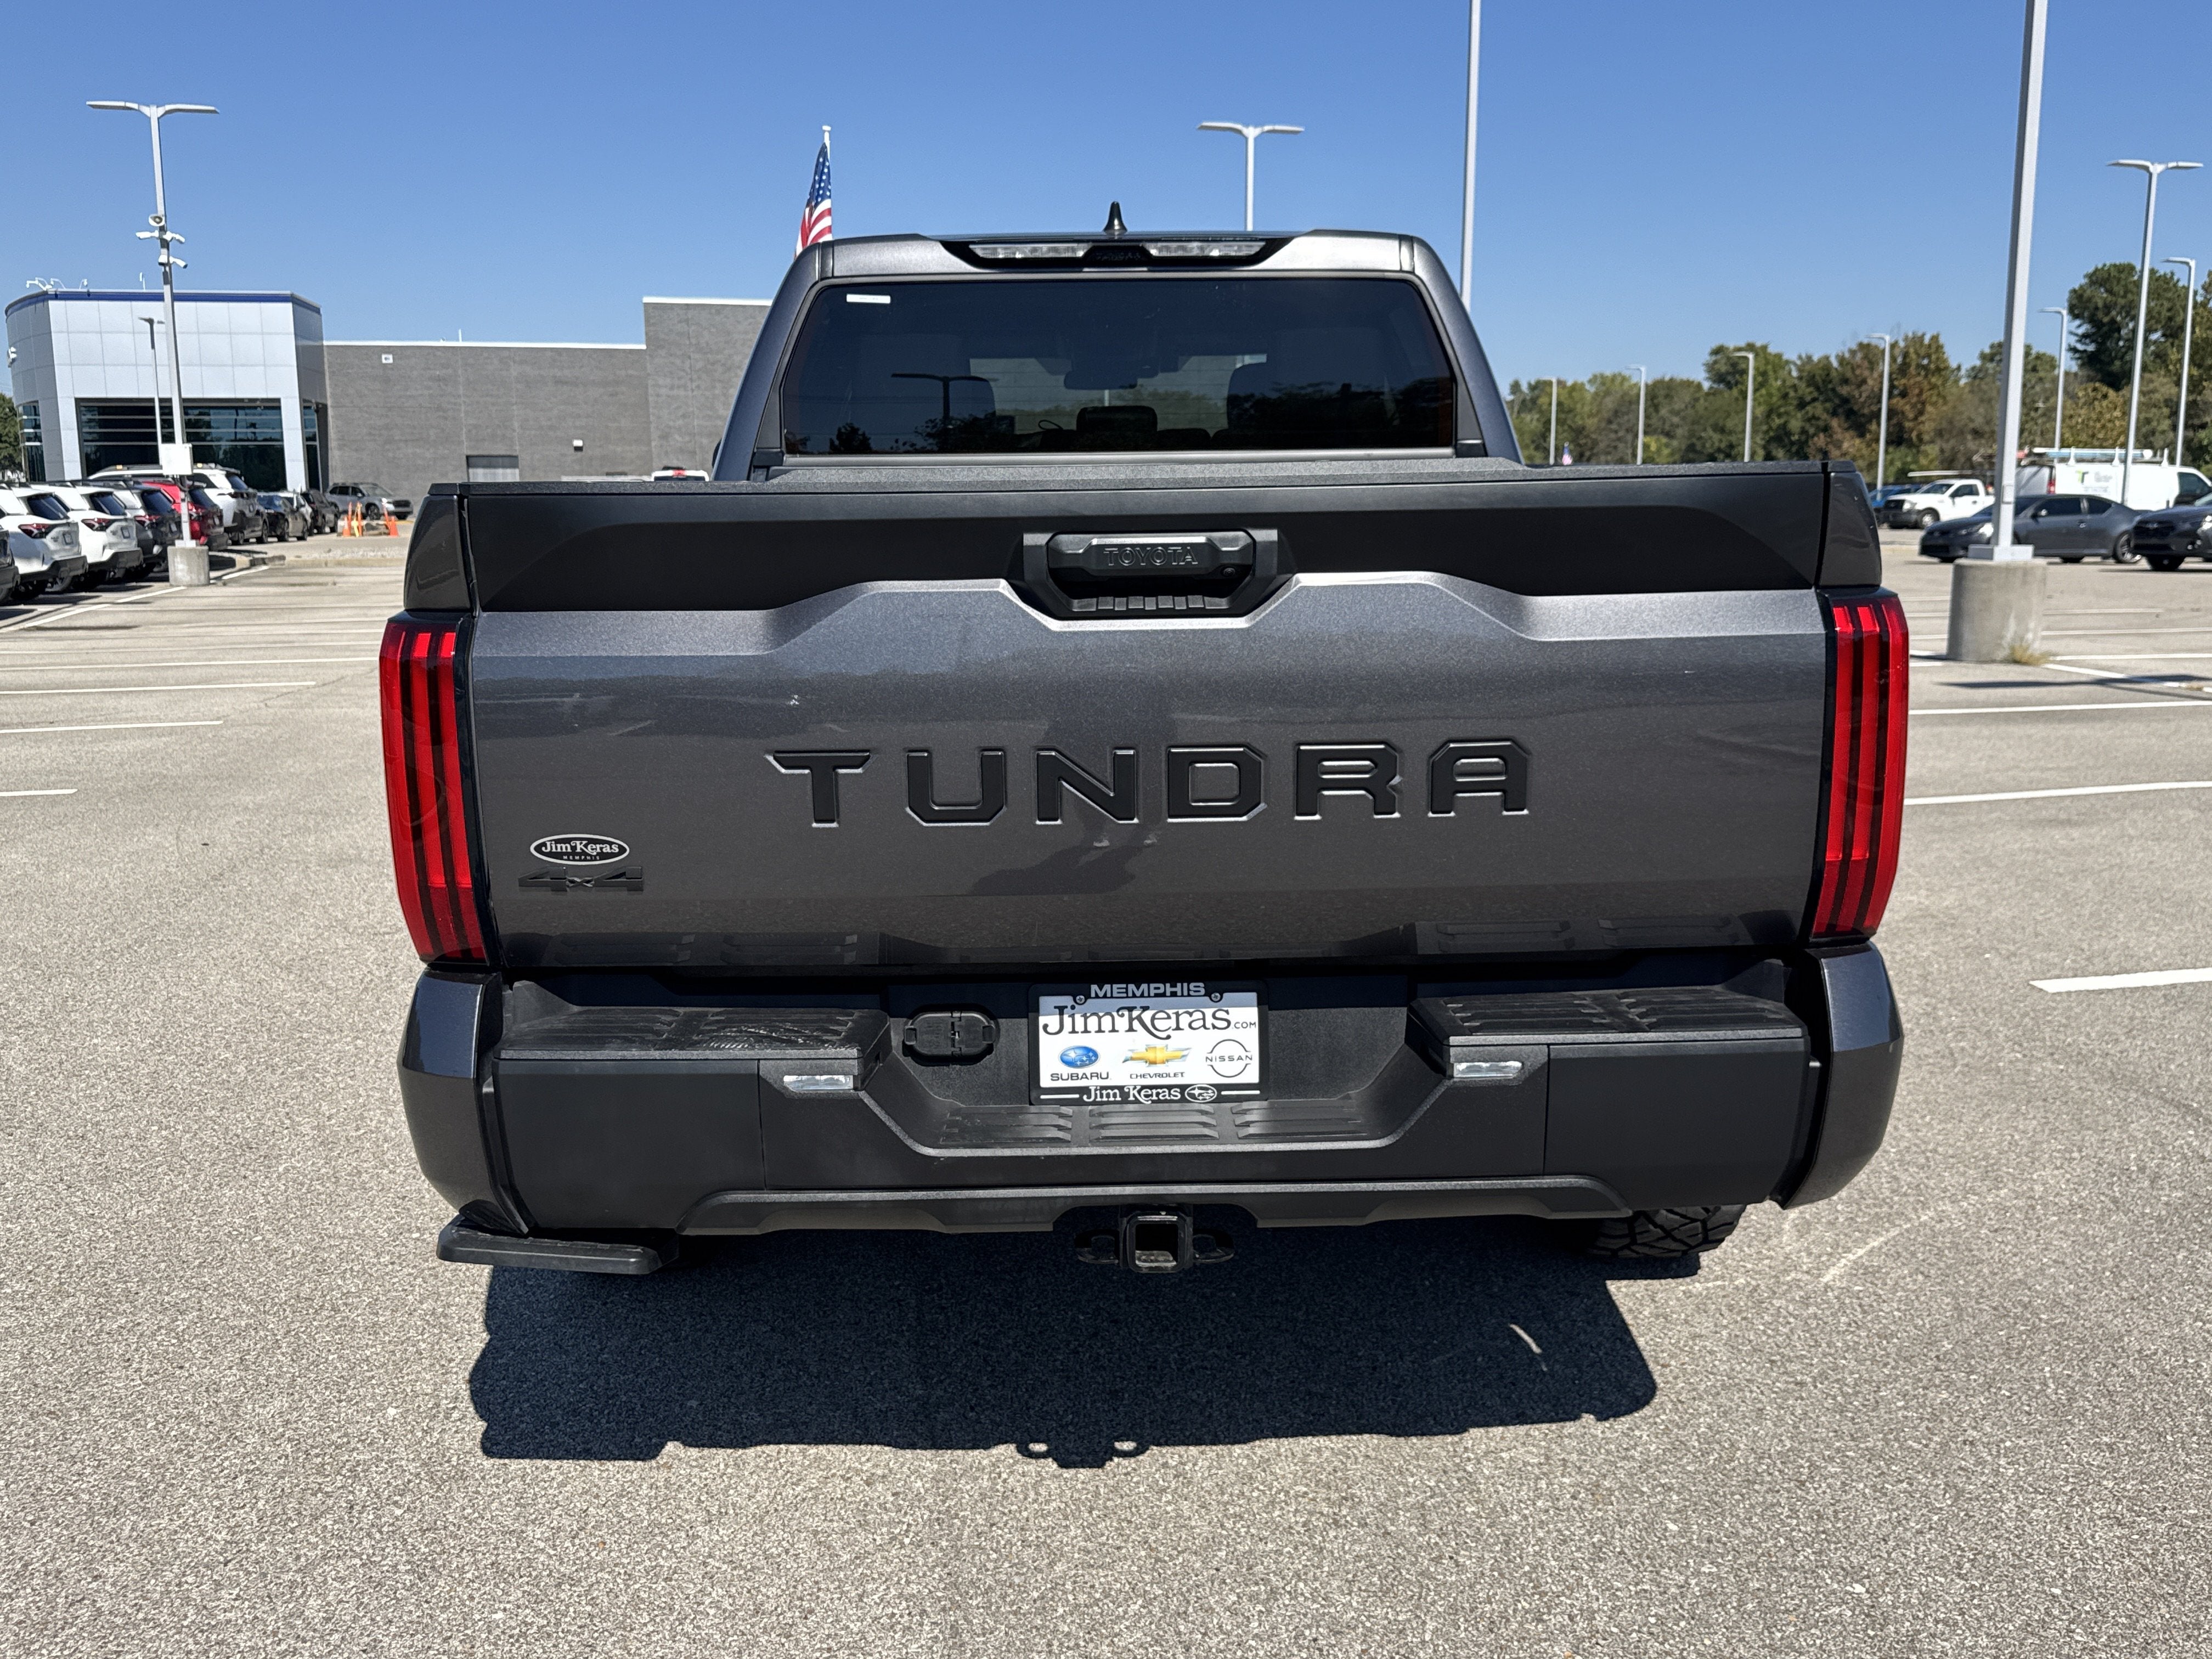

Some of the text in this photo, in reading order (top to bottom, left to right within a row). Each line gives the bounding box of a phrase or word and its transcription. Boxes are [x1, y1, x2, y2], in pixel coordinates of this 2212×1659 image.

[1103, 546, 1198, 566] TOYOTA
[765, 739, 1530, 827] TUNDRA
[1091, 983, 1205, 997] MEMPHIS
[1206, 1054, 1253, 1063] NISSAN
[1050, 1071, 1109, 1081] SUBARU
[1083, 1085, 1181, 1104] Jim Keras
